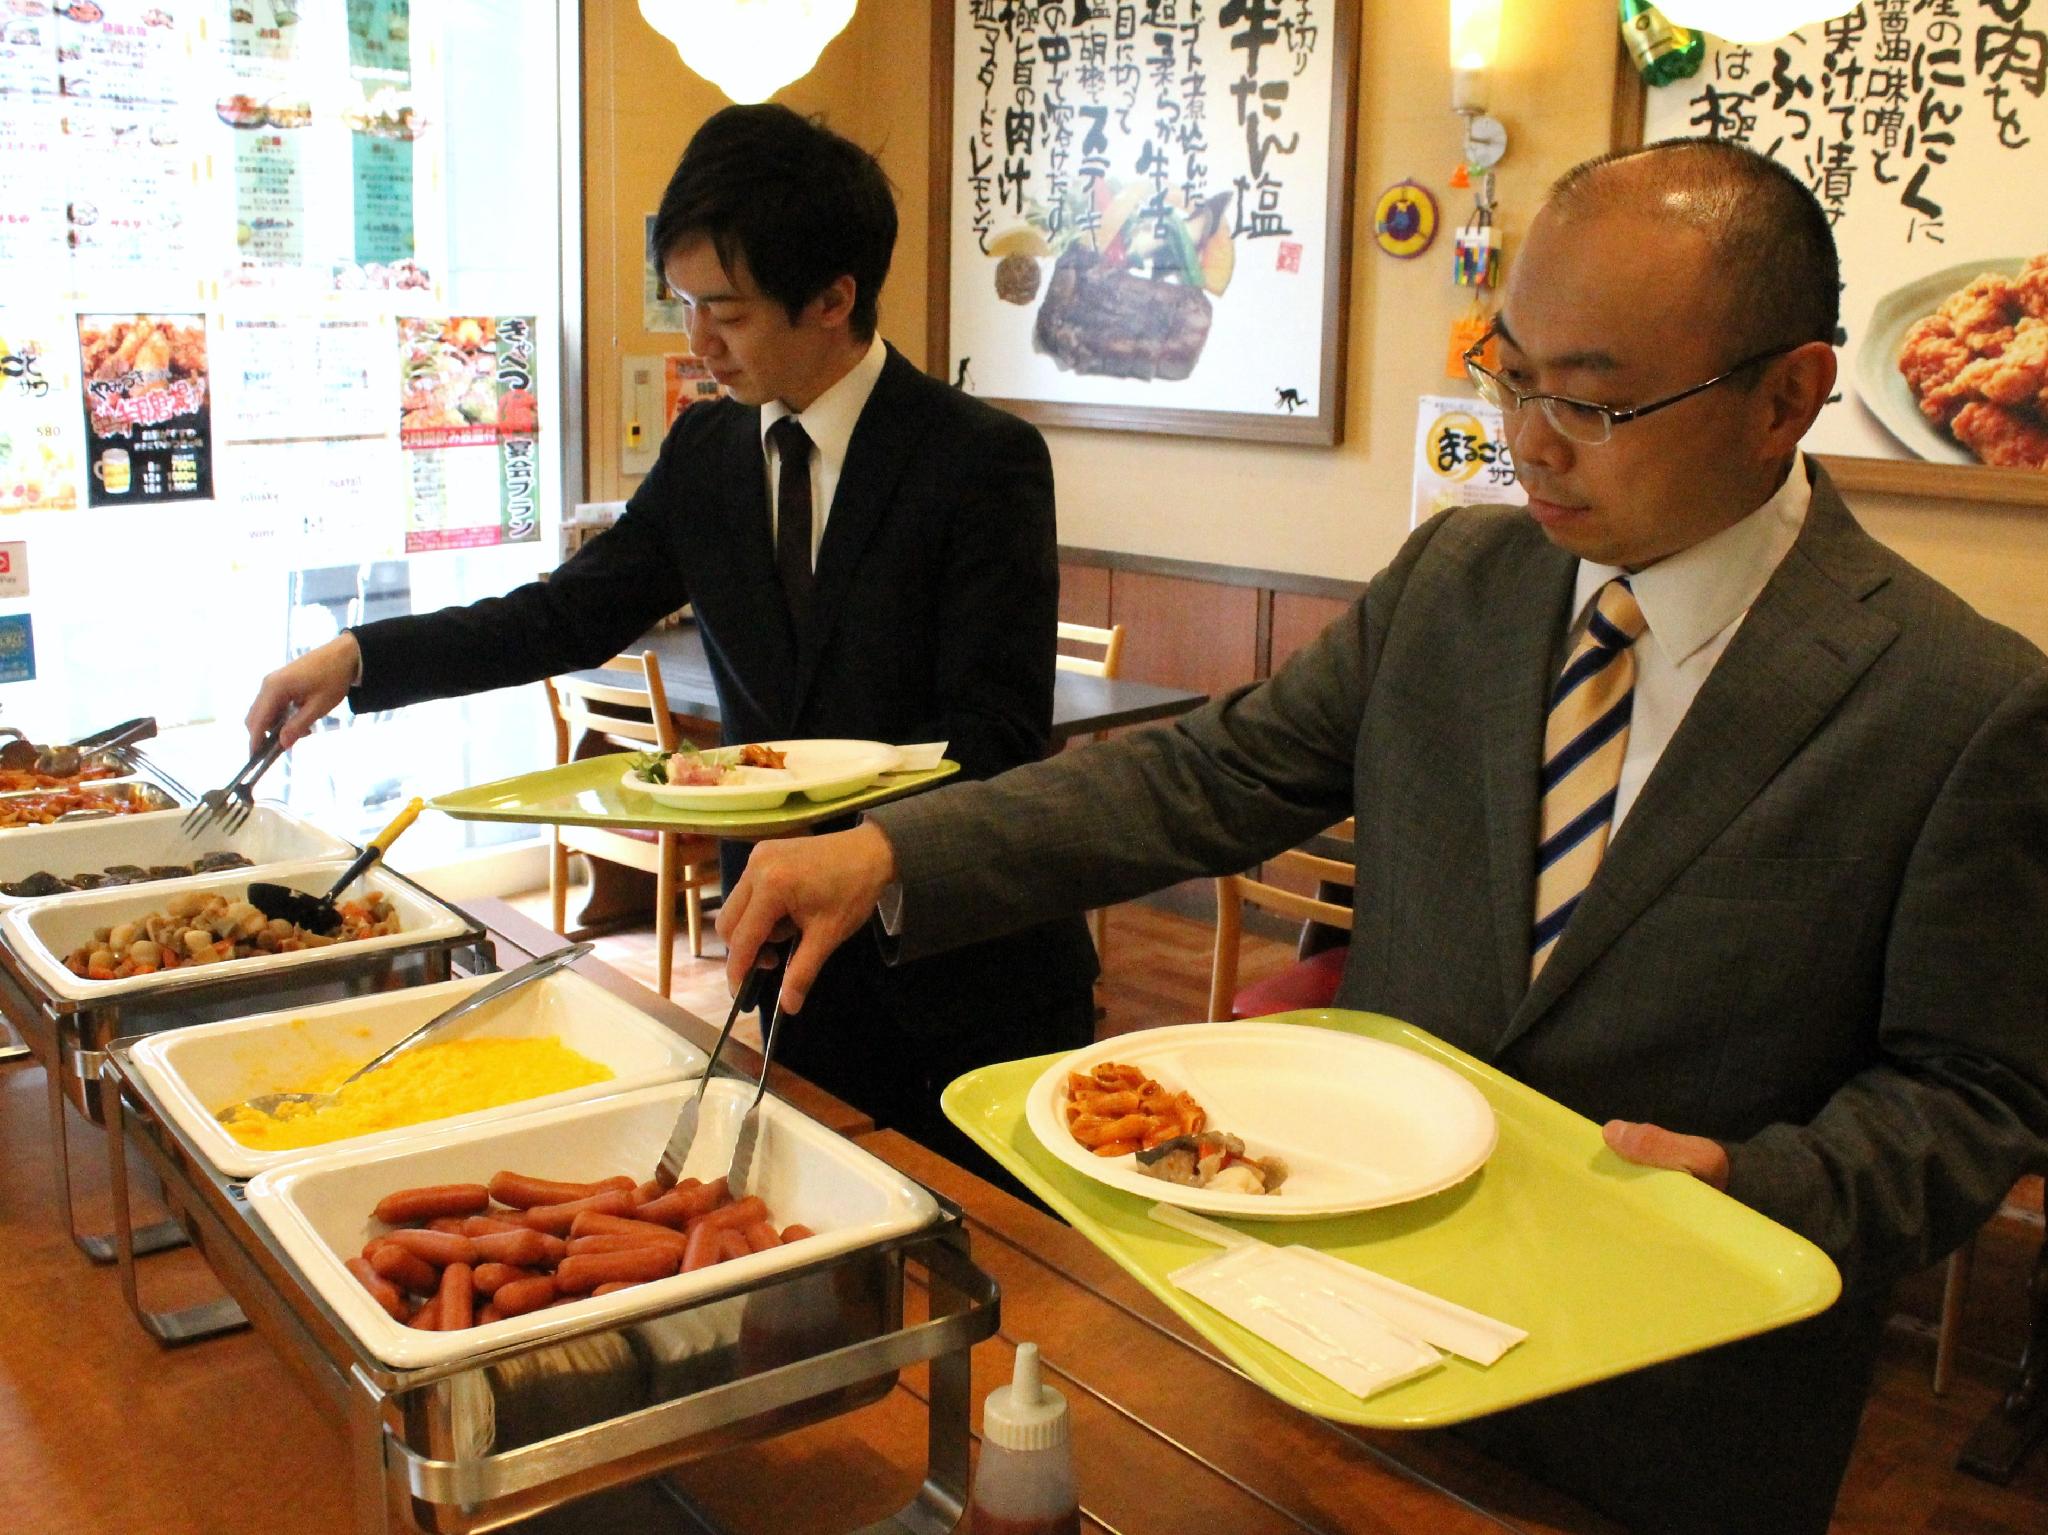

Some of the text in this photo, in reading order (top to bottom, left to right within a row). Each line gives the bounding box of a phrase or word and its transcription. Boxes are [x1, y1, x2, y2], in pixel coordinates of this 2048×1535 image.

[1219, 0, 1300, 239] 牛たん塩
[37, 426, 61, 437] 580
[1437, 427, 1511, 471] まるごと
